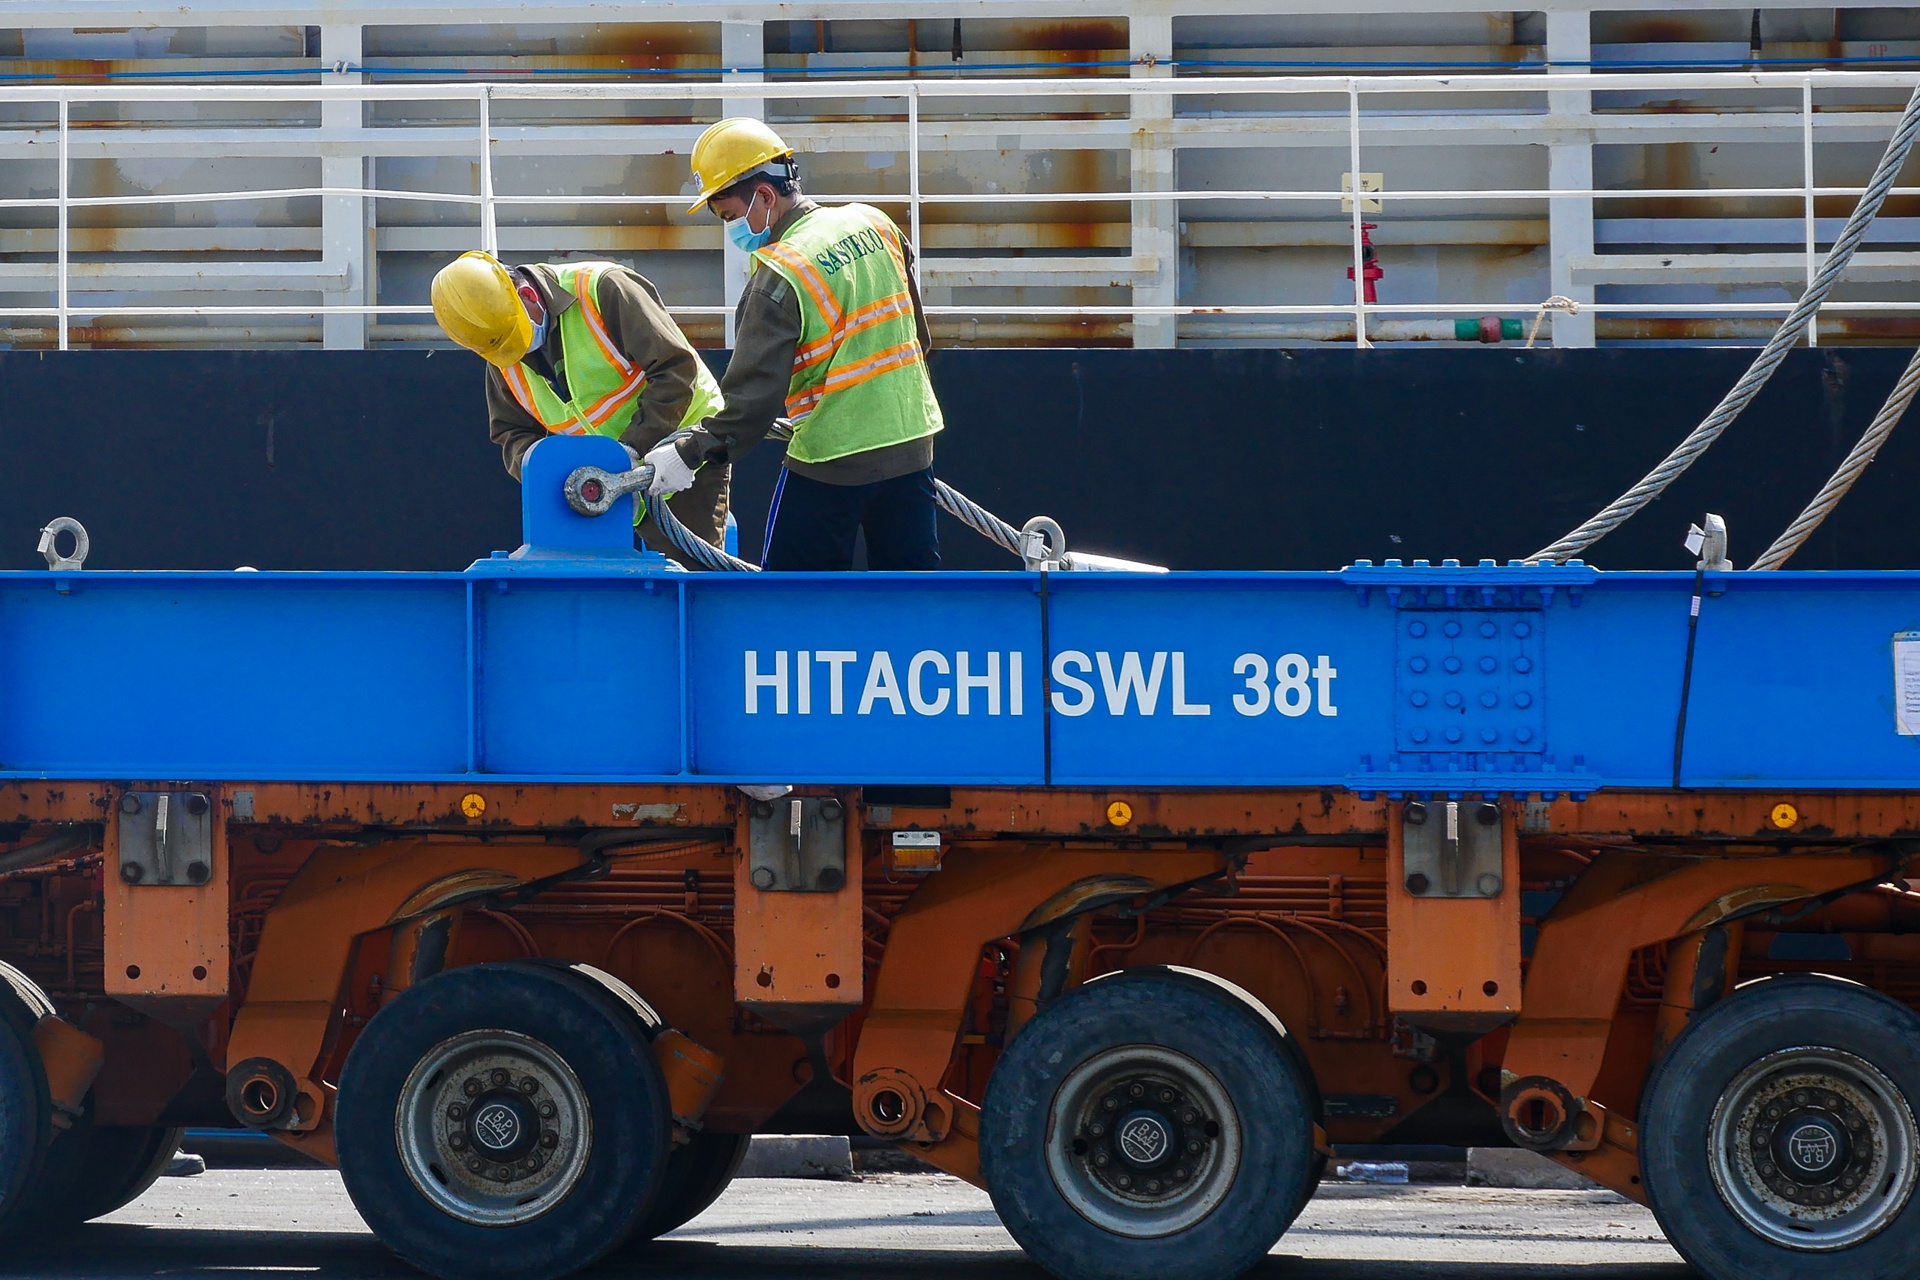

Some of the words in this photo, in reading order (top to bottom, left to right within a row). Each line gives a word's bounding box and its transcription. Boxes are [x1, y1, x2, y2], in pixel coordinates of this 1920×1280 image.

[815, 227, 884, 276] SASTECO
[745, 650, 1023, 716] HITACHI
[1050, 650, 1211, 717] SWL
[1232, 653, 1338, 718] 38t
